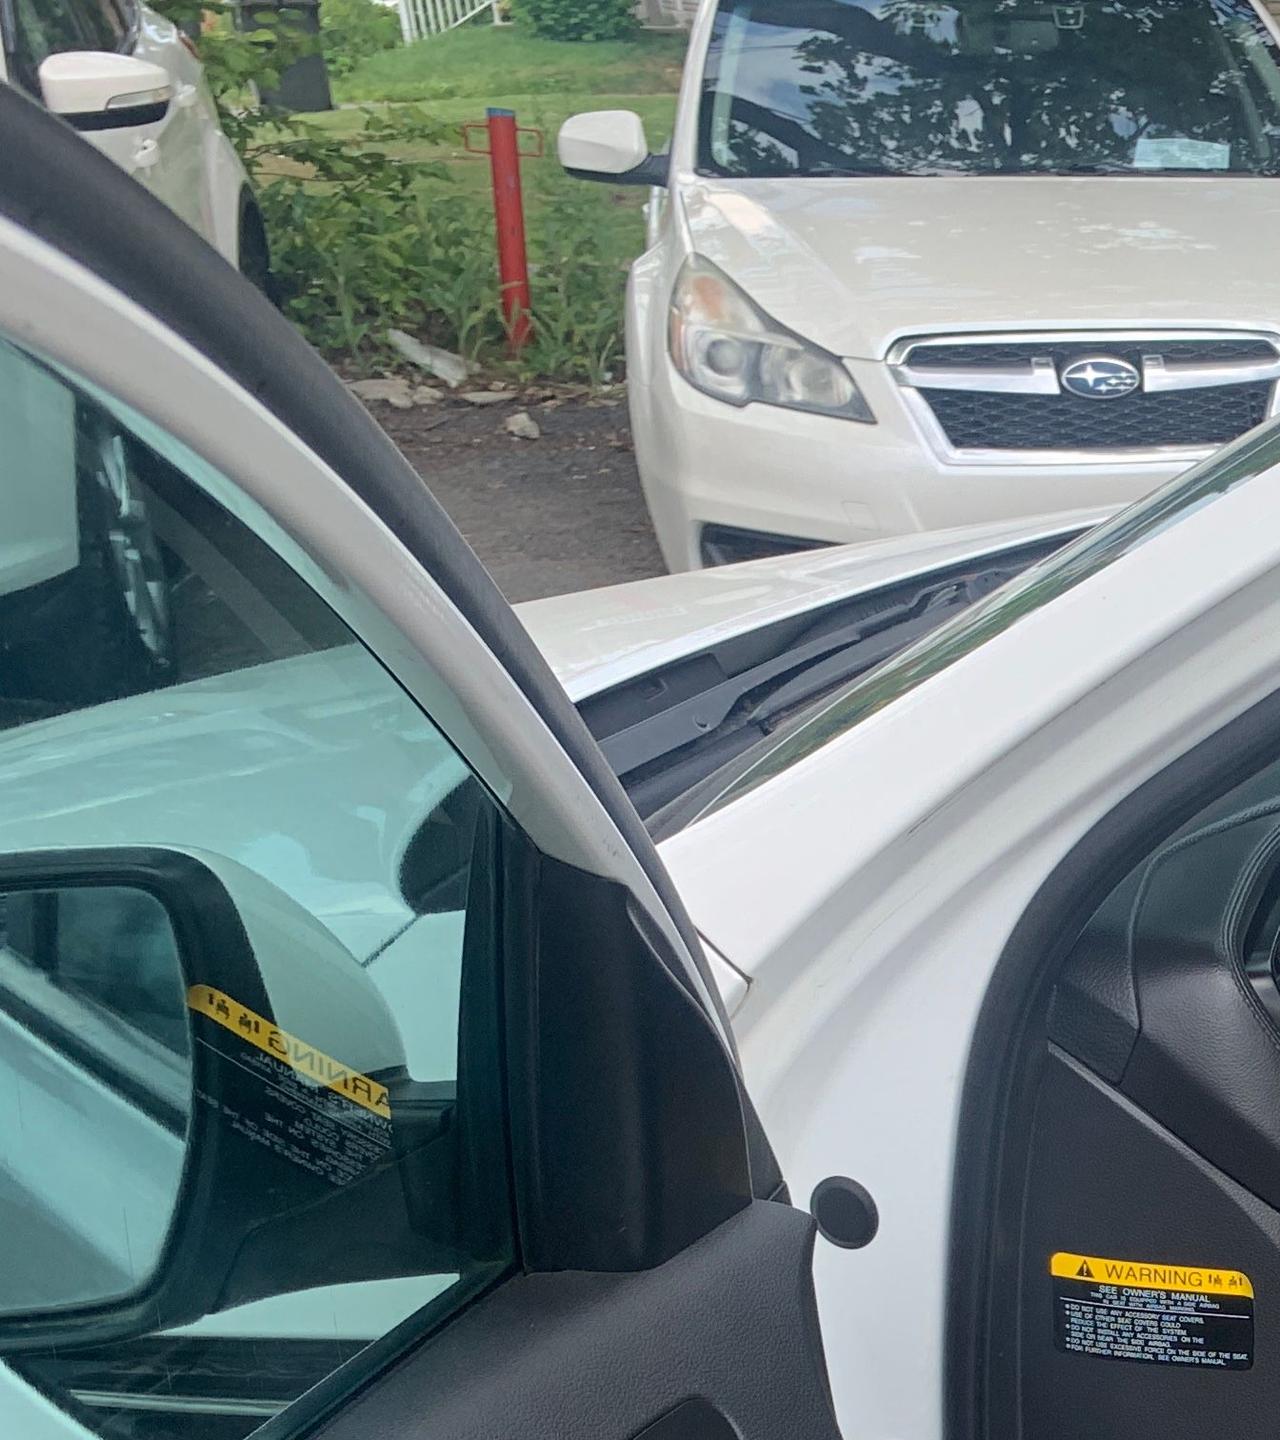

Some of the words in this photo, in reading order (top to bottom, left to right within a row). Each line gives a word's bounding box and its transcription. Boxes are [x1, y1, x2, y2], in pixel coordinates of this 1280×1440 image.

[1104, 1263, 1203, 1288] WARNING
[1099, 1285, 1118, 1294] SEE
[1122, 1288, 1167, 1300] OWNER'S
[1171, 1292, 1210, 1303] MANUAL
